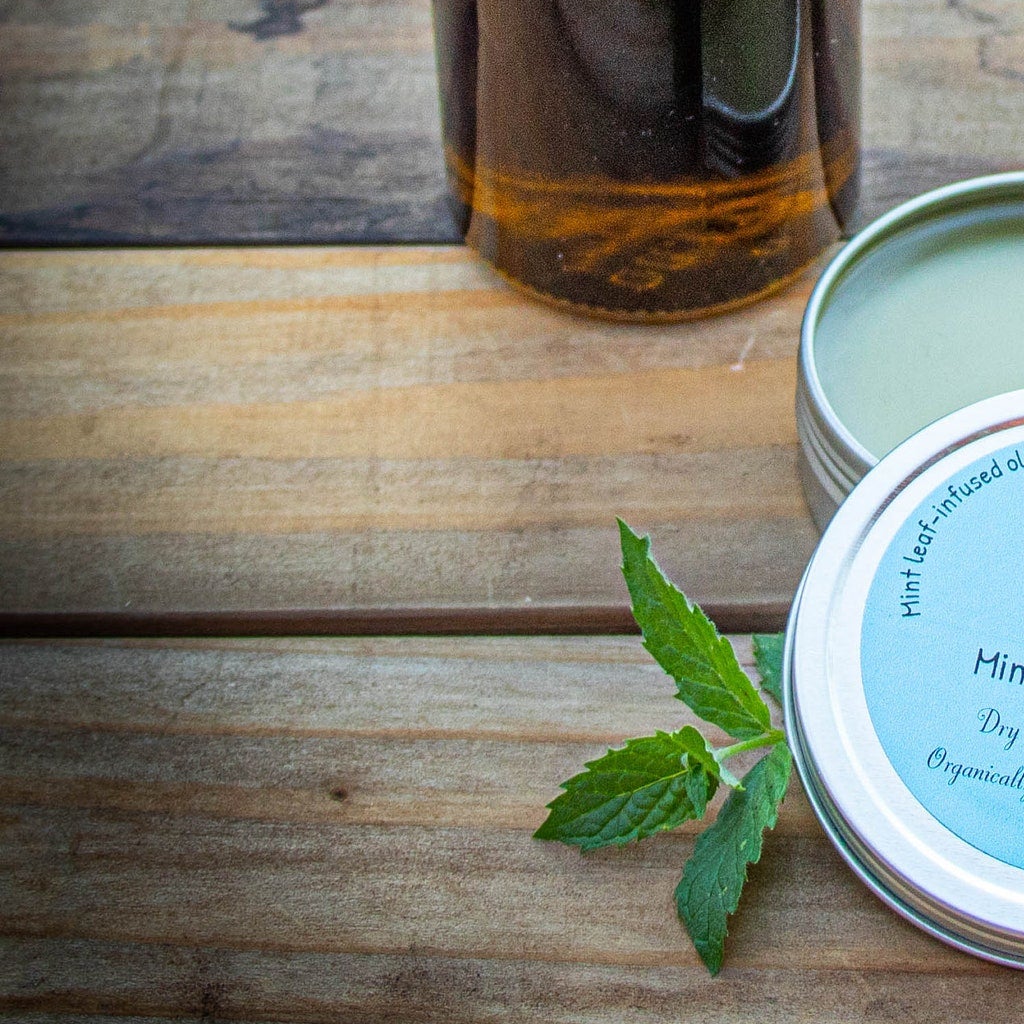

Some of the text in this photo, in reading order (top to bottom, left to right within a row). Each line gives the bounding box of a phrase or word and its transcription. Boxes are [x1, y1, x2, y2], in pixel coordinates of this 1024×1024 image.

[903, 459, 1004, 563] leaf-infused
[900, 568, 922, 618] Mint
[977, 707, 1019, 751] Dry
